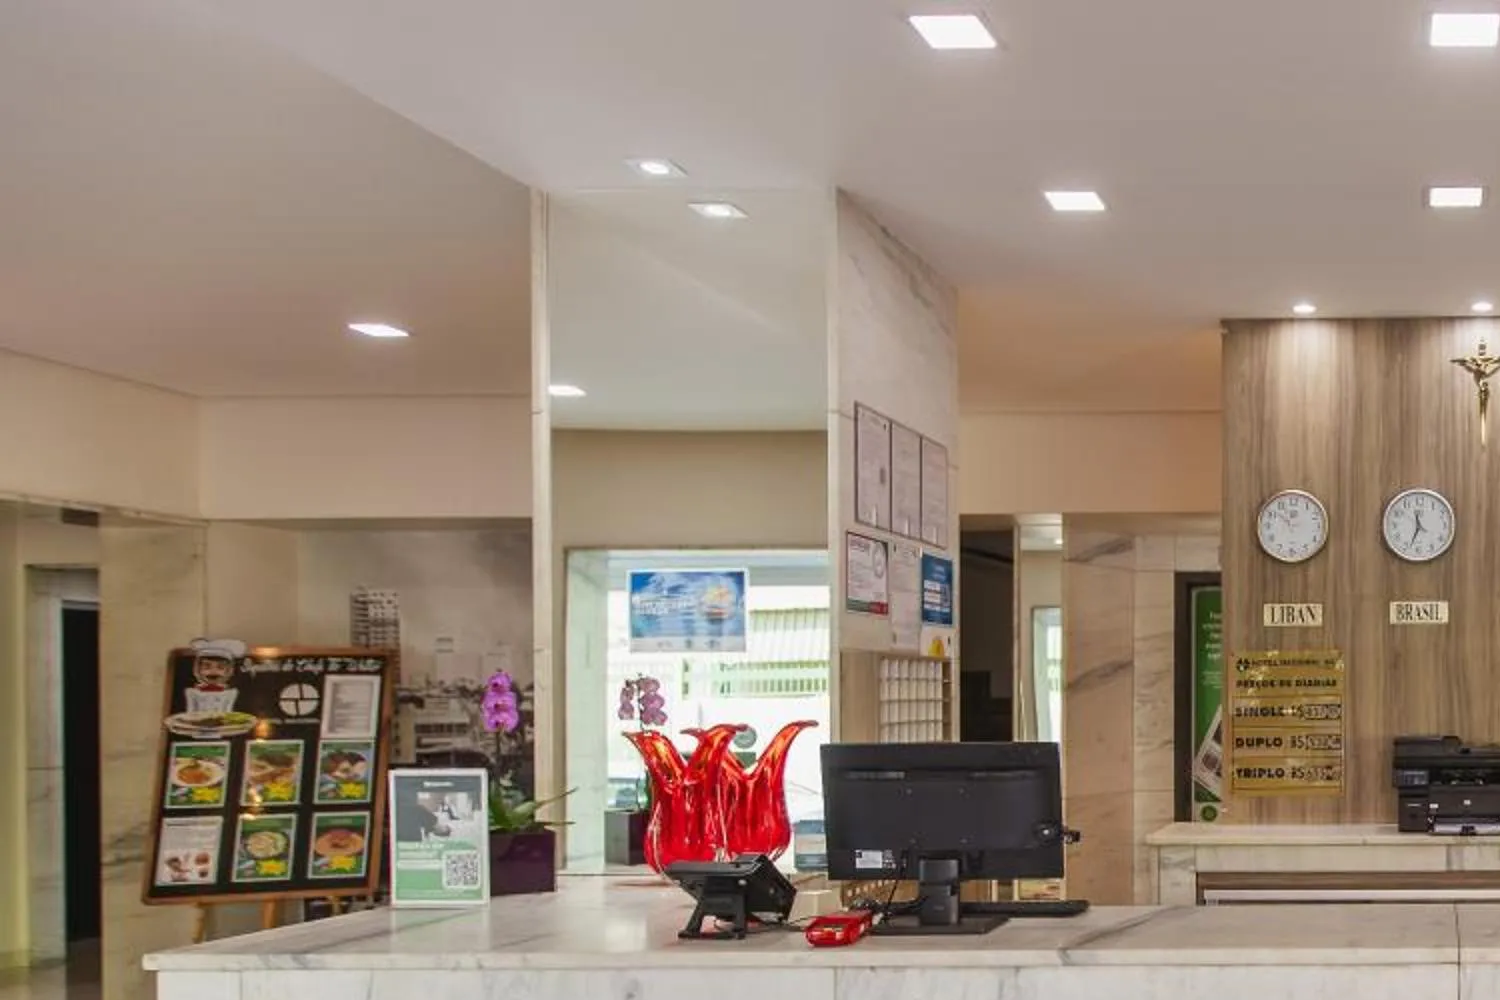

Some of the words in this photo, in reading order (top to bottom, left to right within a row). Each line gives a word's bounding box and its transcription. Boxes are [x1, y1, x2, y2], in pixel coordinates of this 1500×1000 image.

[1269, 604, 1317, 624] LIBAN
[1395, 603, 1443, 621] BRASIL
[1235, 737, 1283, 749] DUPLO
[1235, 767, 1285, 779] TRIPLO
